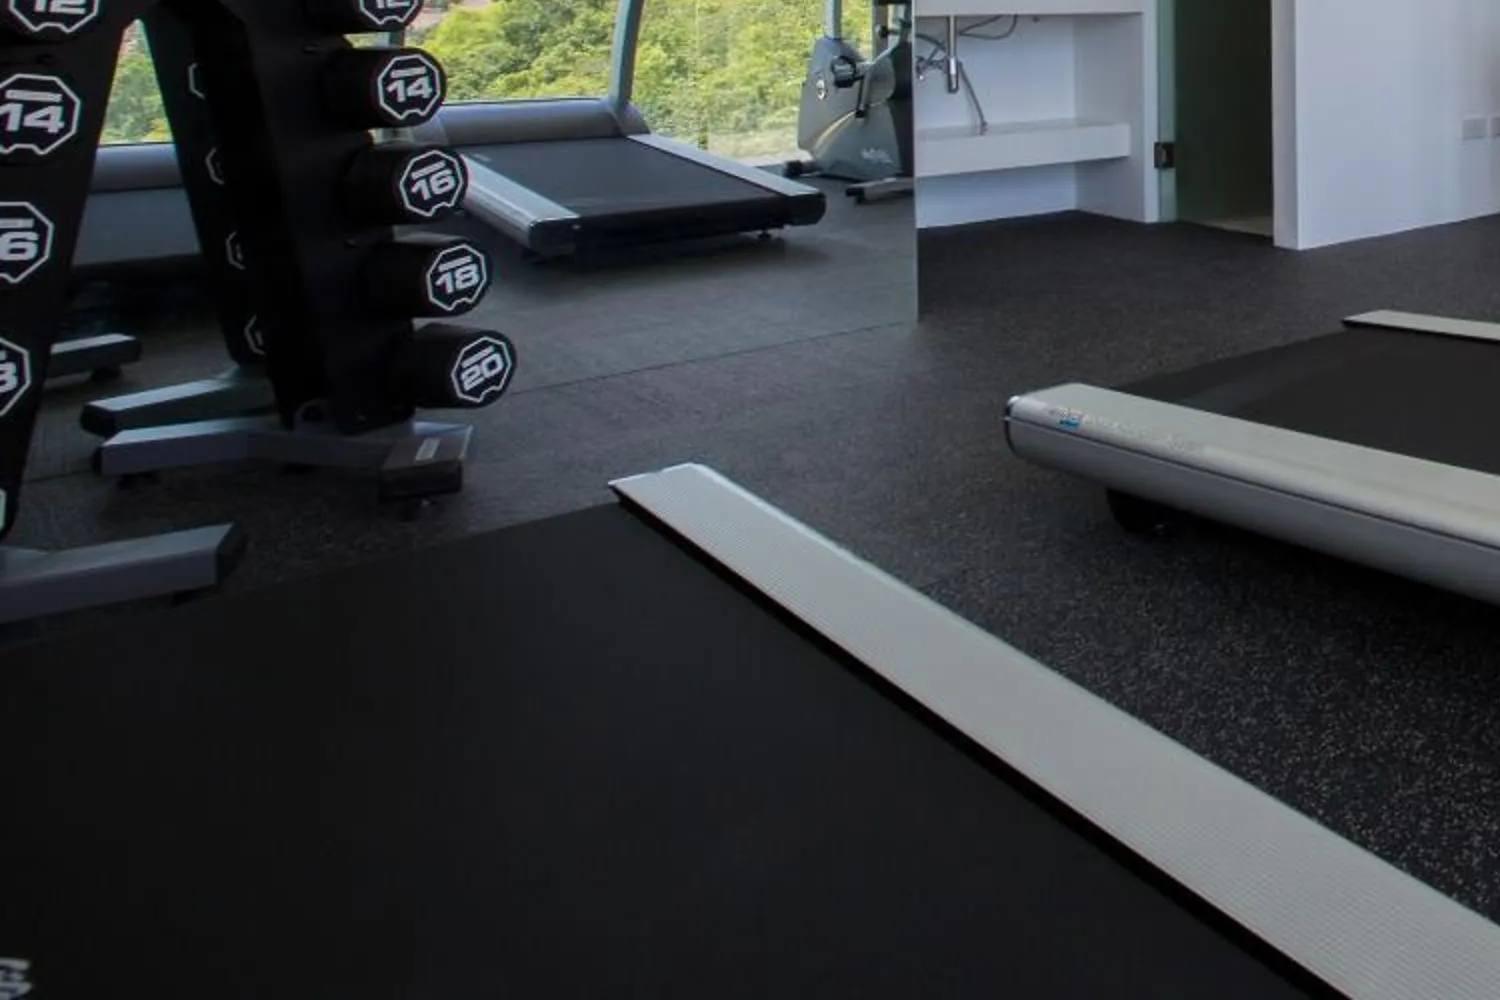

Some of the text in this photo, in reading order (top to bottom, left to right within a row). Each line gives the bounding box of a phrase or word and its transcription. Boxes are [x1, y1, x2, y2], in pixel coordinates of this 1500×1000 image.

[386, 75, 433, 103] 14
[0, 102, 65, 134] 14
[410, 168, 456, 201] 16
[435, 262, 480, 294] 18
[460, 353, 504, 392] 20
